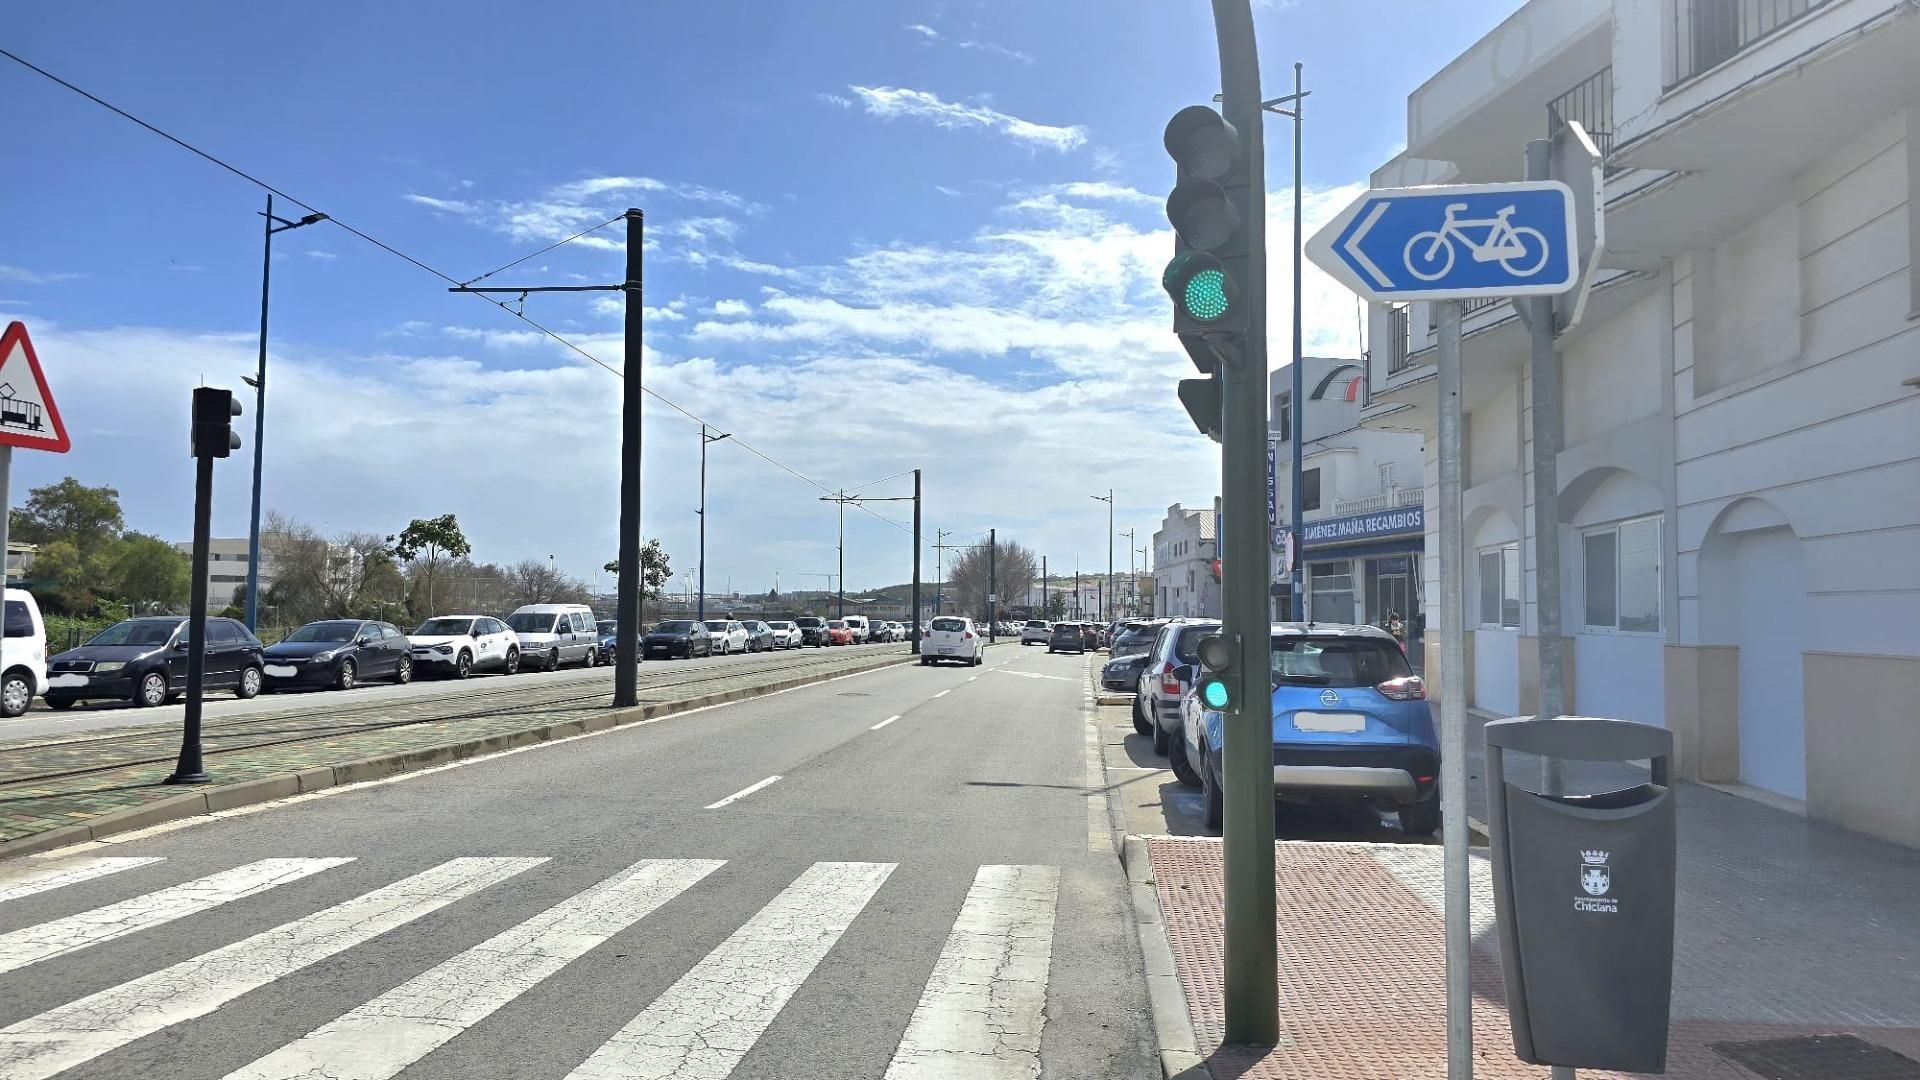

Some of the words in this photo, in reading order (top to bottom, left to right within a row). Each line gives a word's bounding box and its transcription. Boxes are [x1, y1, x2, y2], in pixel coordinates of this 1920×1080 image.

[1304, 522, 1337, 540] JIMÉNEZ
[1338, 517, 1364, 536] MAÑA
[1366, 511, 1421, 532] RECAMBIOS
[1574, 901, 1618, 913] Chiclana
